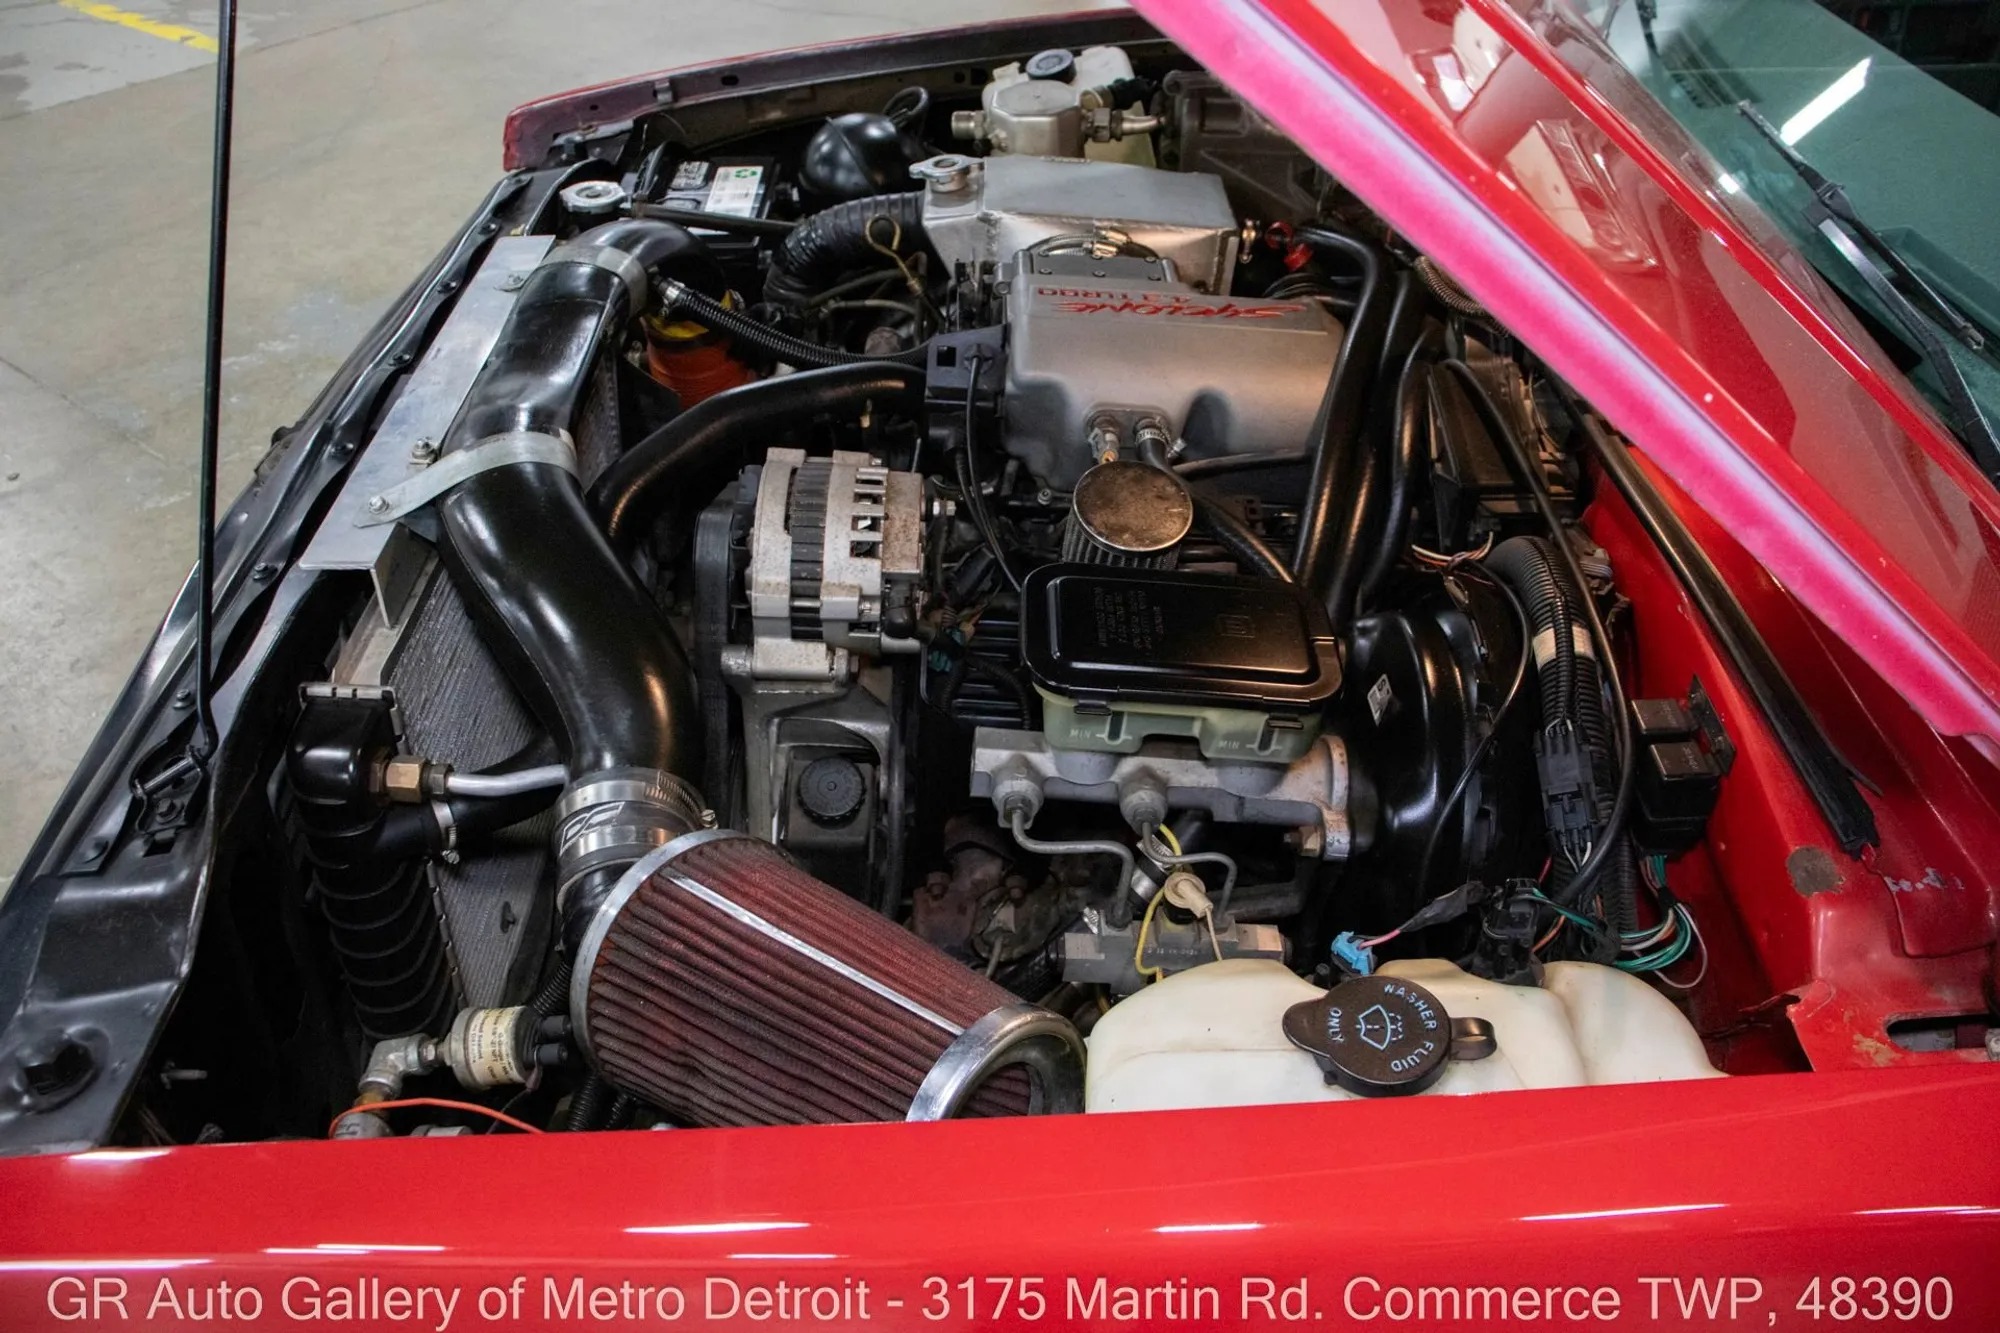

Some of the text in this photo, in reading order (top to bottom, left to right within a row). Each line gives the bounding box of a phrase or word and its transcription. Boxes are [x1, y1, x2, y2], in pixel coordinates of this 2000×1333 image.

[1069, 728, 1092, 739] MIN
[1218, 740, 1241, 749] MIN
[1327, 983, 1438, 1072] WASHER FLUID ONLY
